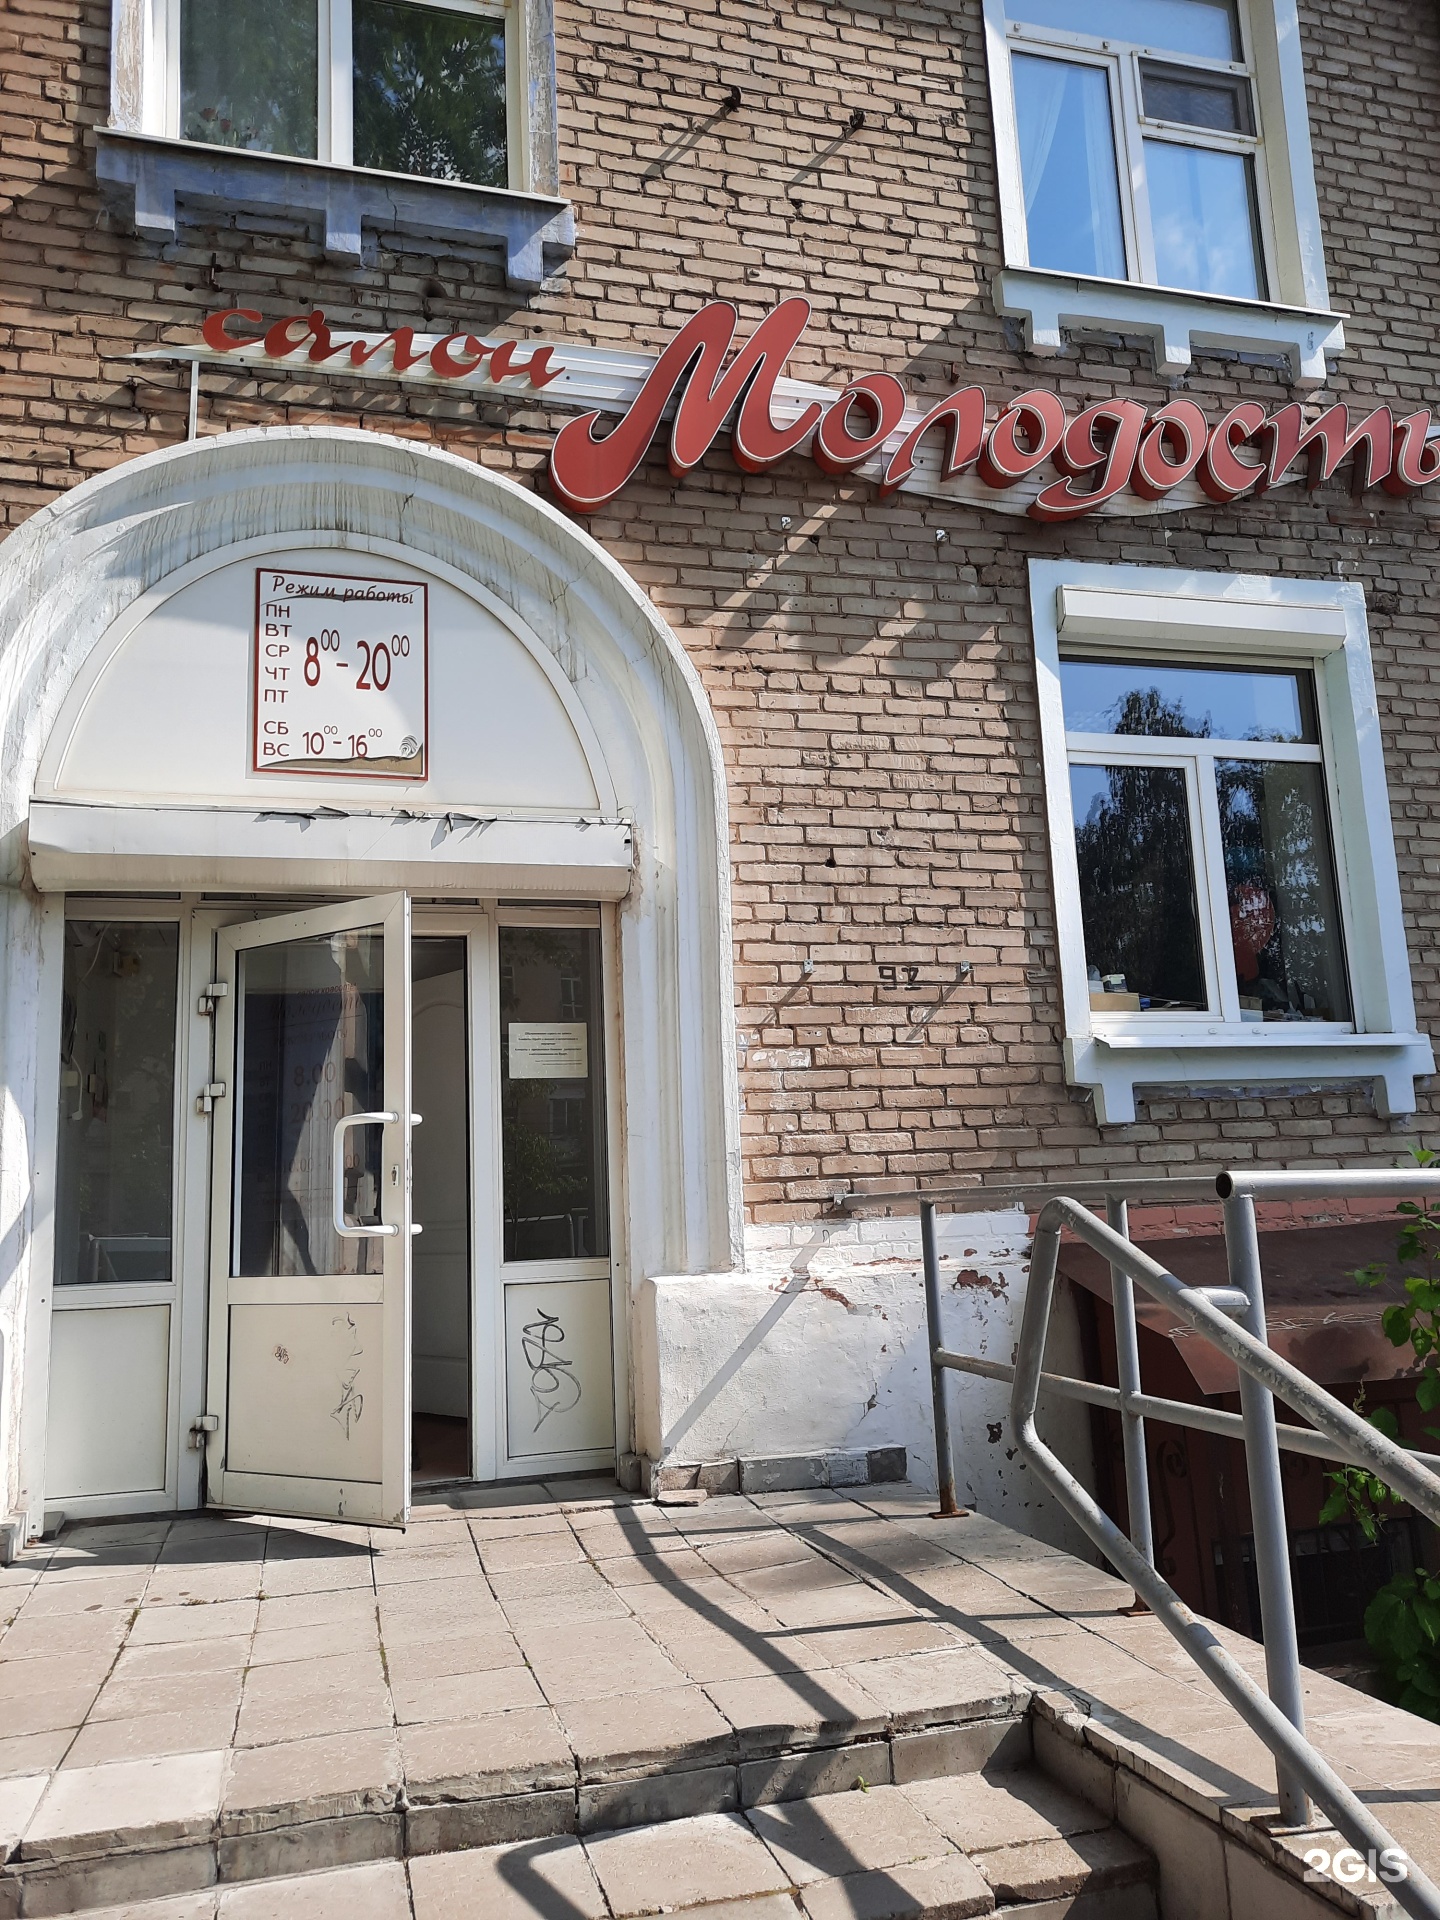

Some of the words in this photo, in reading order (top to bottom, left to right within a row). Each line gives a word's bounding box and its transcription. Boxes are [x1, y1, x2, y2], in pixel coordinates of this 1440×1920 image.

[202, 308, 565, 388] салон
[549, 297, 1440, 521] Молодость
[272, 576, 336, 597] Режим
[342, 585, 414, 604] работы
[265, 604, 290, 618] ПН
[265, 624, 292, 637] ВТ
[265, 644, 290, 657] СР
[265, 667, 290, 681] ЧТ
[264, 689, 289, 703] ПТ
[263, 721, 289, 735] СБ
[263, 742, 290, 757] ВС
